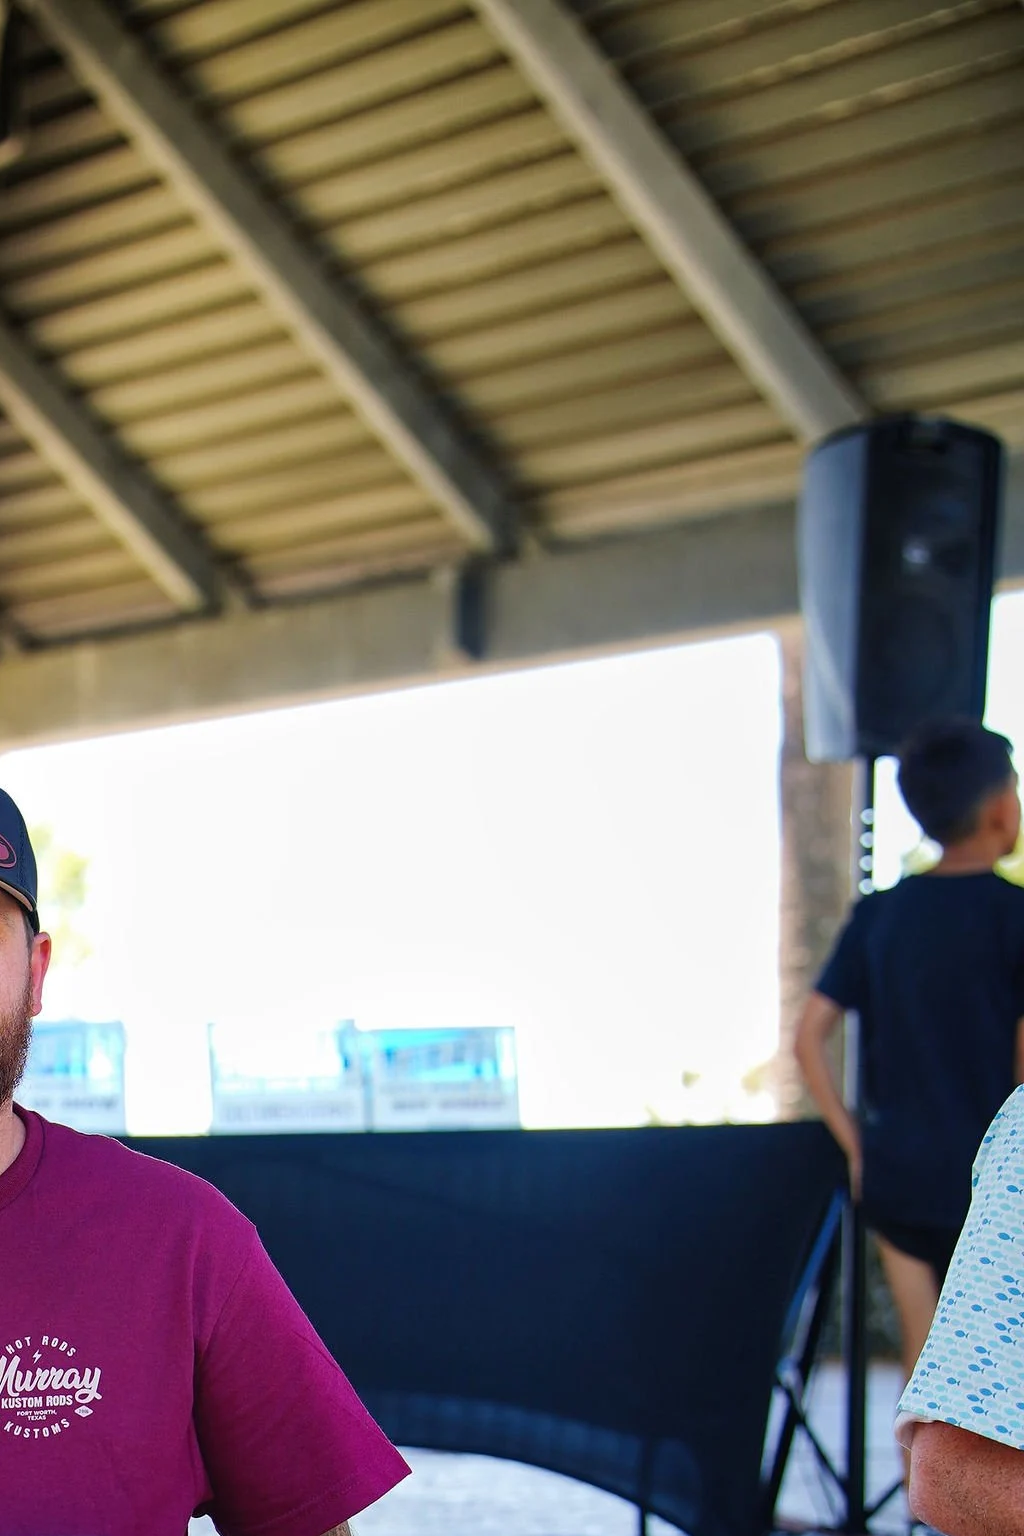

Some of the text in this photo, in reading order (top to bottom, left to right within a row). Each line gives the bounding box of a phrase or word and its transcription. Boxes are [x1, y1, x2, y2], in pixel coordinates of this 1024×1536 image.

[6, 1335, 76, 1357] HOT RODS
[1, 1394, 73, 1409] KUSTOM RODS
[4, 1418, 70, 1439] KUSTOMS
